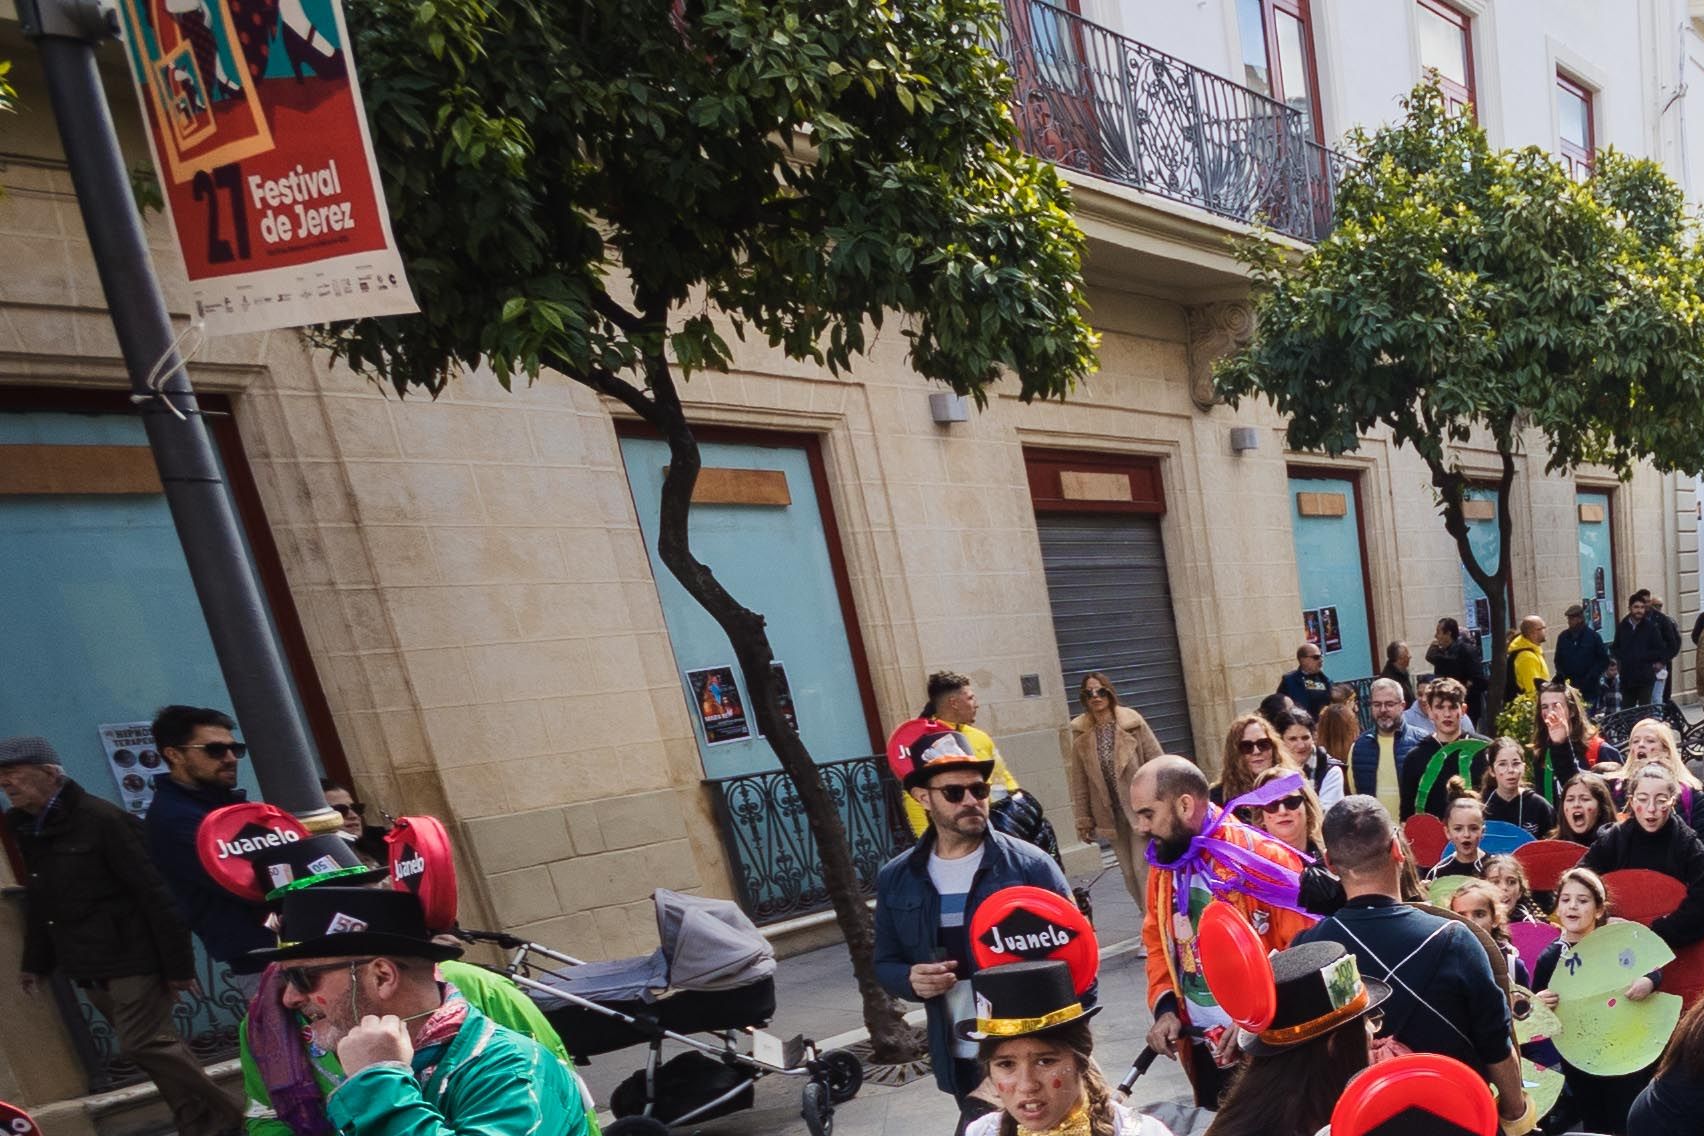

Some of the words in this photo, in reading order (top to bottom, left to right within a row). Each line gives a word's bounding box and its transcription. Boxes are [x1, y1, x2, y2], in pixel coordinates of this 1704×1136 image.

[193, 163, 250, 264] 27
[248, 159, 342, 209] Festival
[260, 210, 293, 244] de
[294, 201, 355, 239] Jerez
[215, 826, 300, 860] Juanelo
[393, 851, 425, 882] Juanelo
[989, 924, 1071, 955] Juanelo
[1335, 960, 1354, 980] 100
